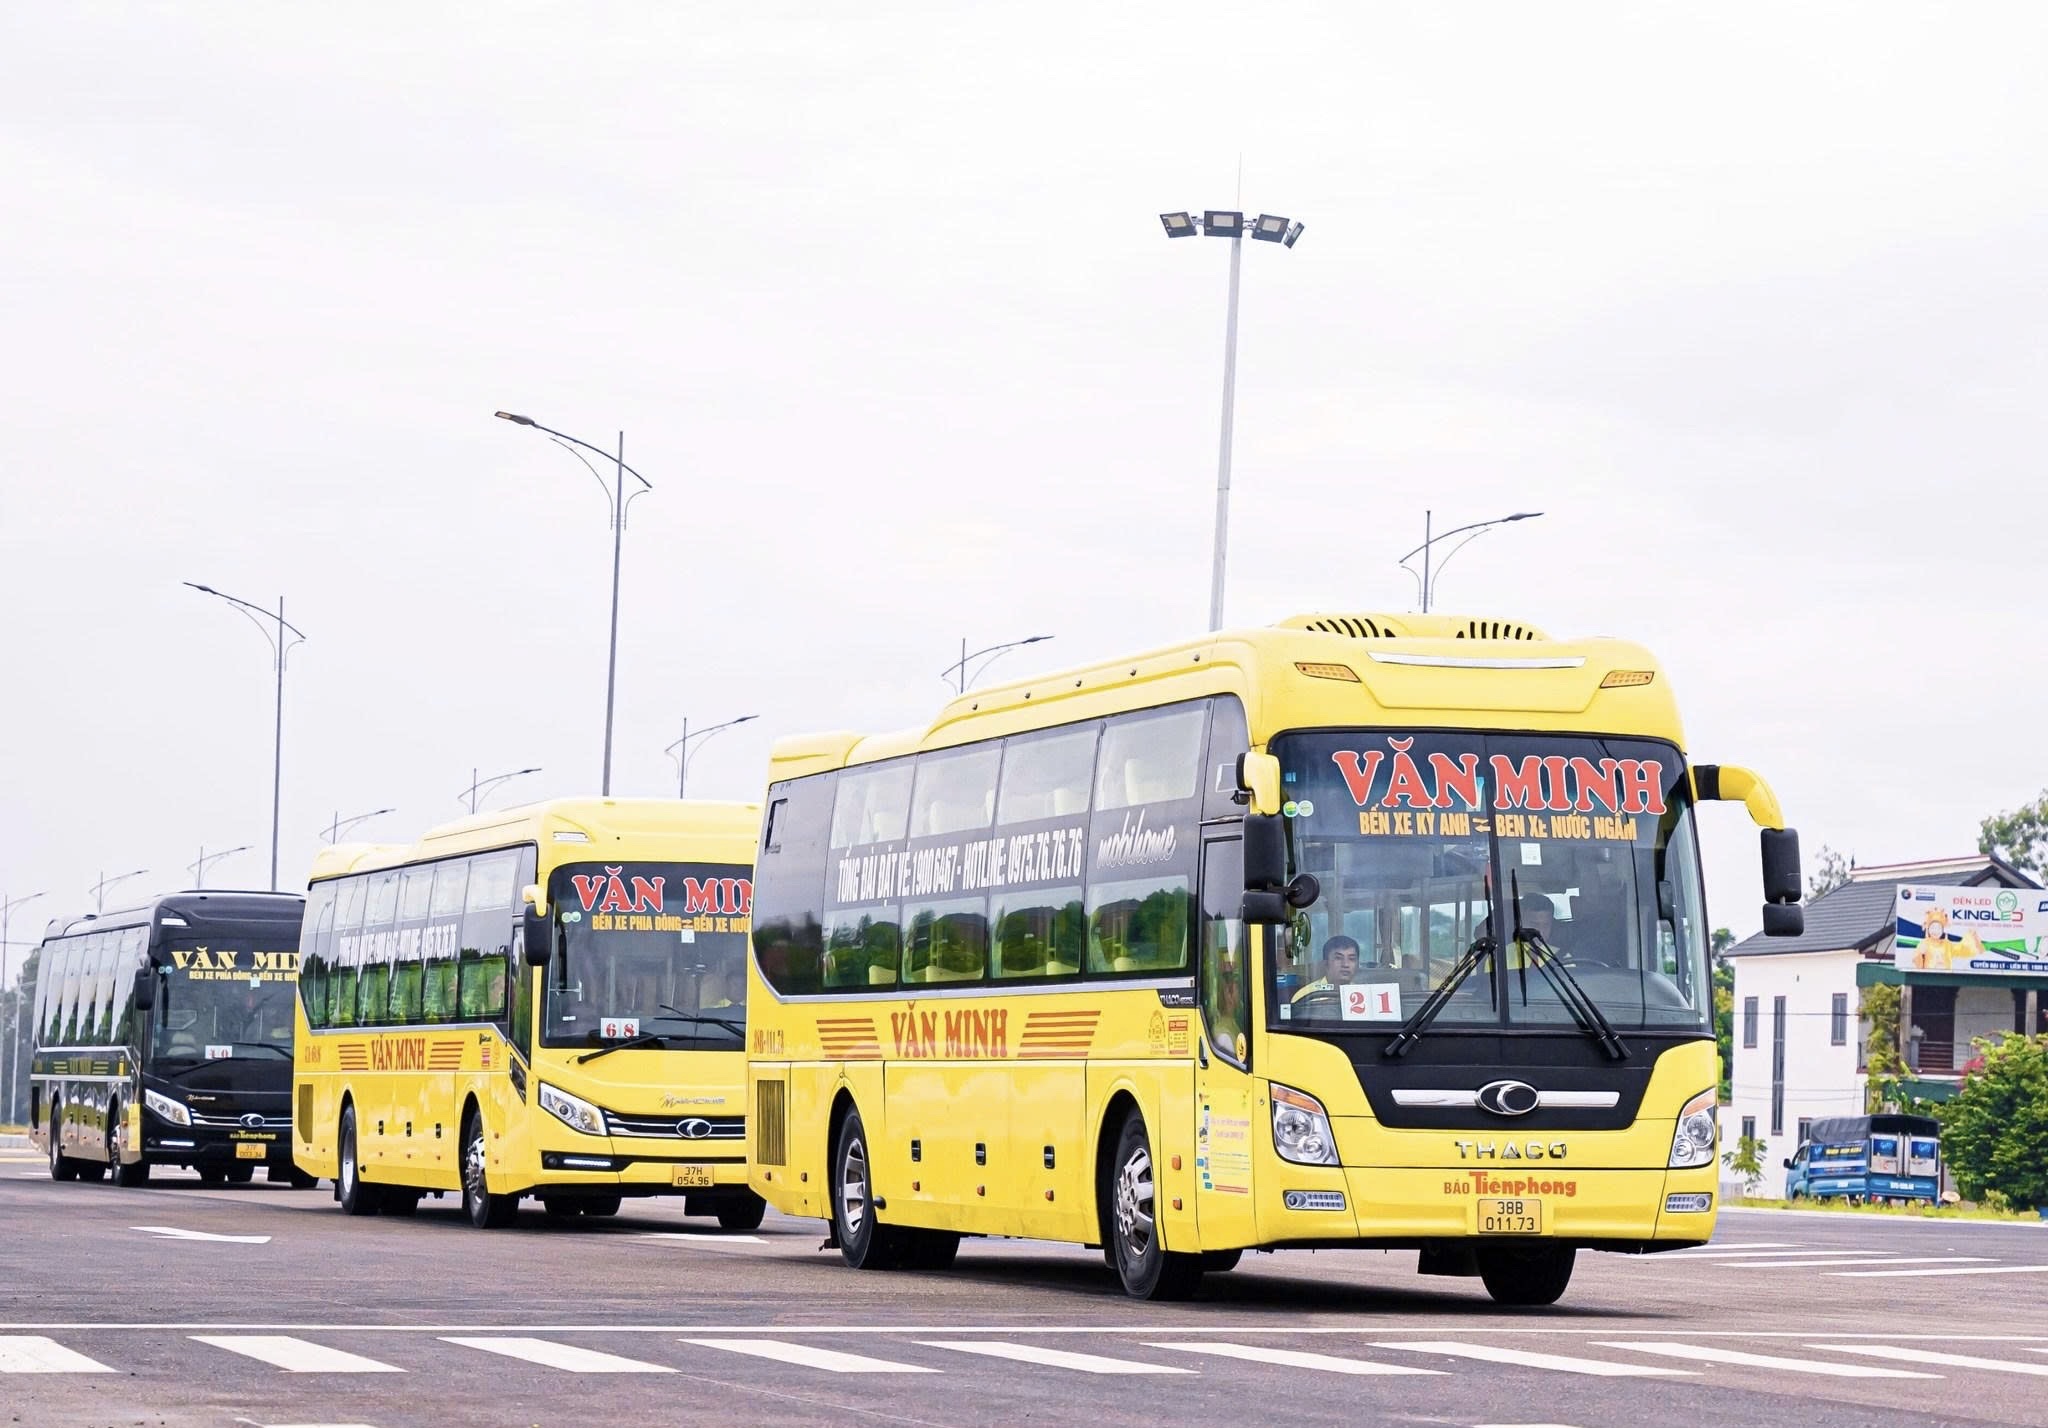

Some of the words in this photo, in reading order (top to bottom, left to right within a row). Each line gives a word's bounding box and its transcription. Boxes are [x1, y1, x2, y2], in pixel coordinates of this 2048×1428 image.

[1332, 737, 1479, 809] VĂN
[1489, 754, 1667, 815] MINH
[1359, 803, 1391, 835] BẾN
[1393, 812, 1414, 835] XE
[1439, 813, 1471, 836] ANH
[1550, 809, 1591, 840] NƯỚC
[1007, 826, 1083, 885] 0975.76.76.76
[571, 864, 665, 912] VĂN
[1975, 898, 1991, 906] LED
[591, 911, 612, 931] BẾN
[614, 915, 627, 931] XE
[654, 912, 682, 932] ĐÔNG
[715, 916, 728, 933] XE
[1952, 909, 2024, 922] KINGLED
[171, 946, 238, 970] VĂN
[890, 1000, 938, 1059] VĂN
[945, 1009, 1009, 1058] MINH
[371, 1032, 394, 1070] VĂN
[396, 1038, 426, 1070] MINH
[1454, 1140, 1568, 1160] THACO
[685, 1166, 703, 1176] 37H
[1496, 1201, 1524, 1215] 38B
[1485, 1216, 1535, 1231] 011.73
